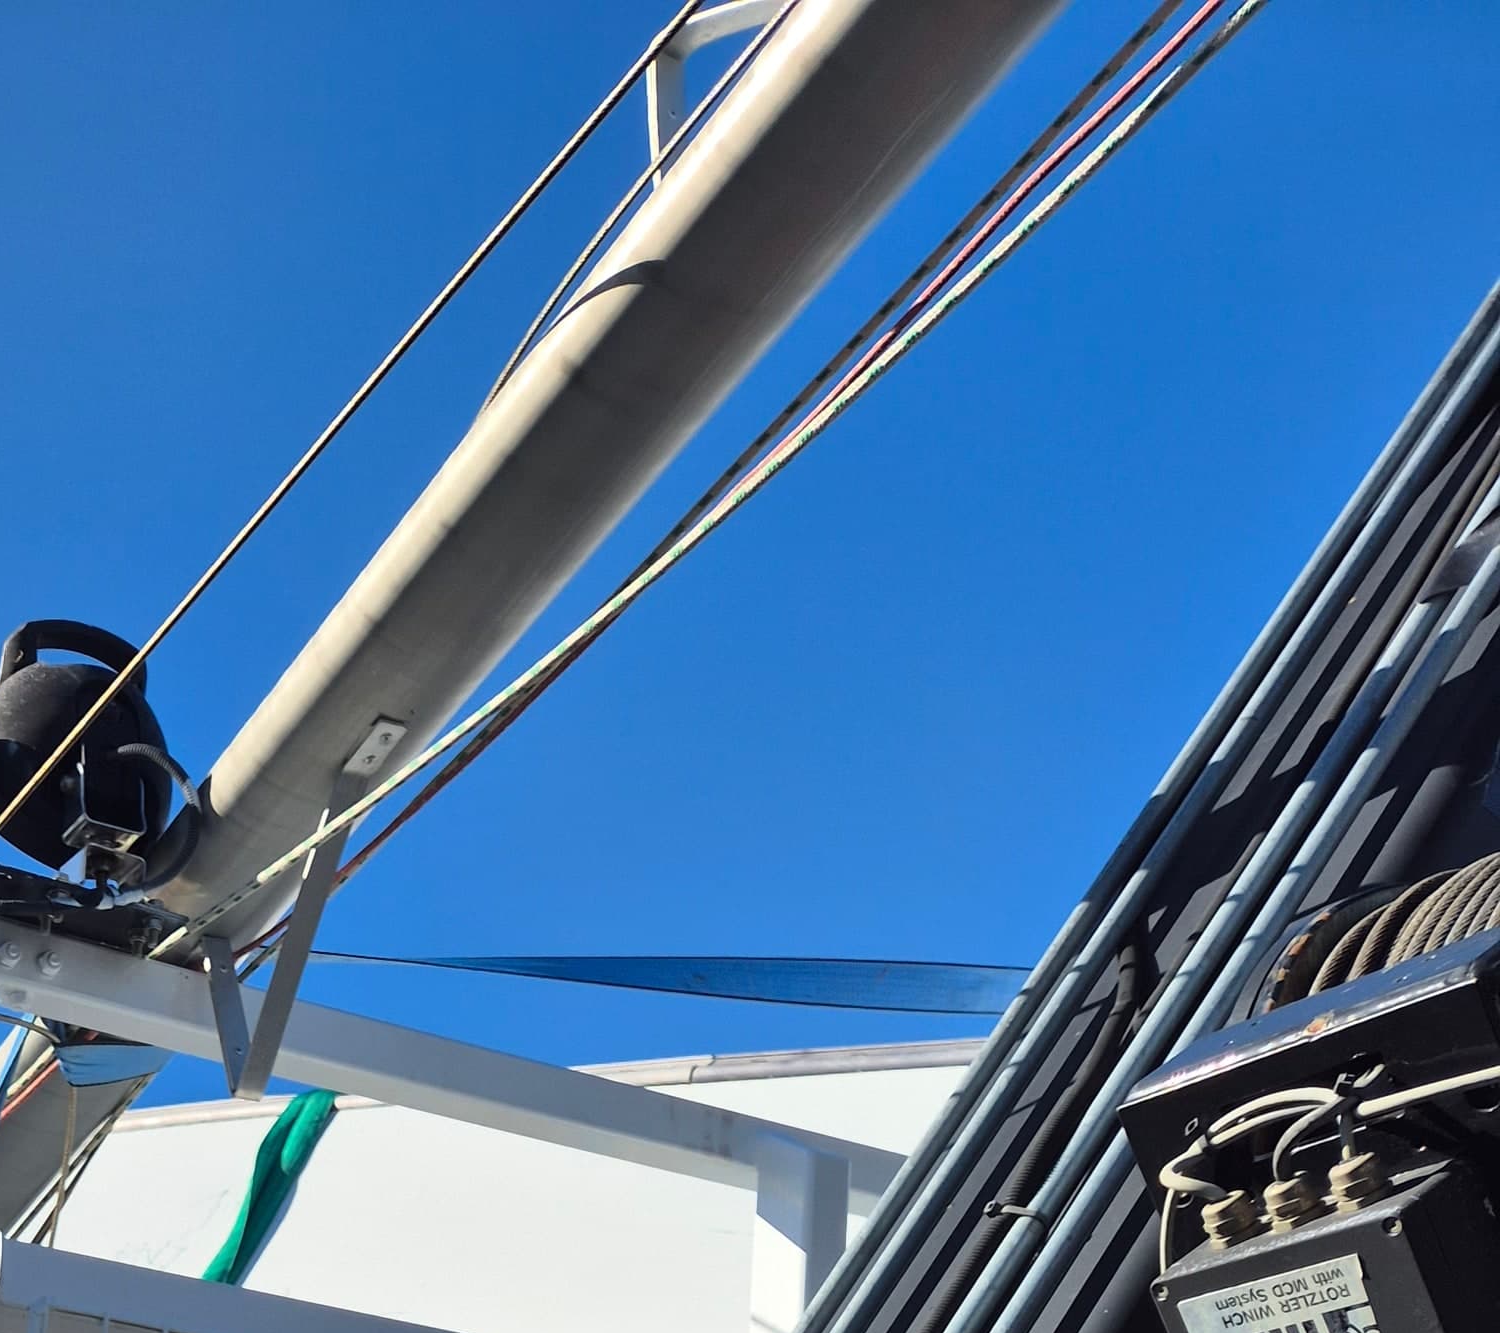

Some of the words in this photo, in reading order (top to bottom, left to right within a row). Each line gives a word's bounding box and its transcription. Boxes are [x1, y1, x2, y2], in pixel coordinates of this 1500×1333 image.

[1271, 1278, 1308, 1298] MCD
[1312, 1267, 1345, 1287] with
[1215, 1289, 1269, 1311] System
[1280, 1283, 1352, 1315] ROTZLER
[1222, 1304, 1276, 1329] WINCH
